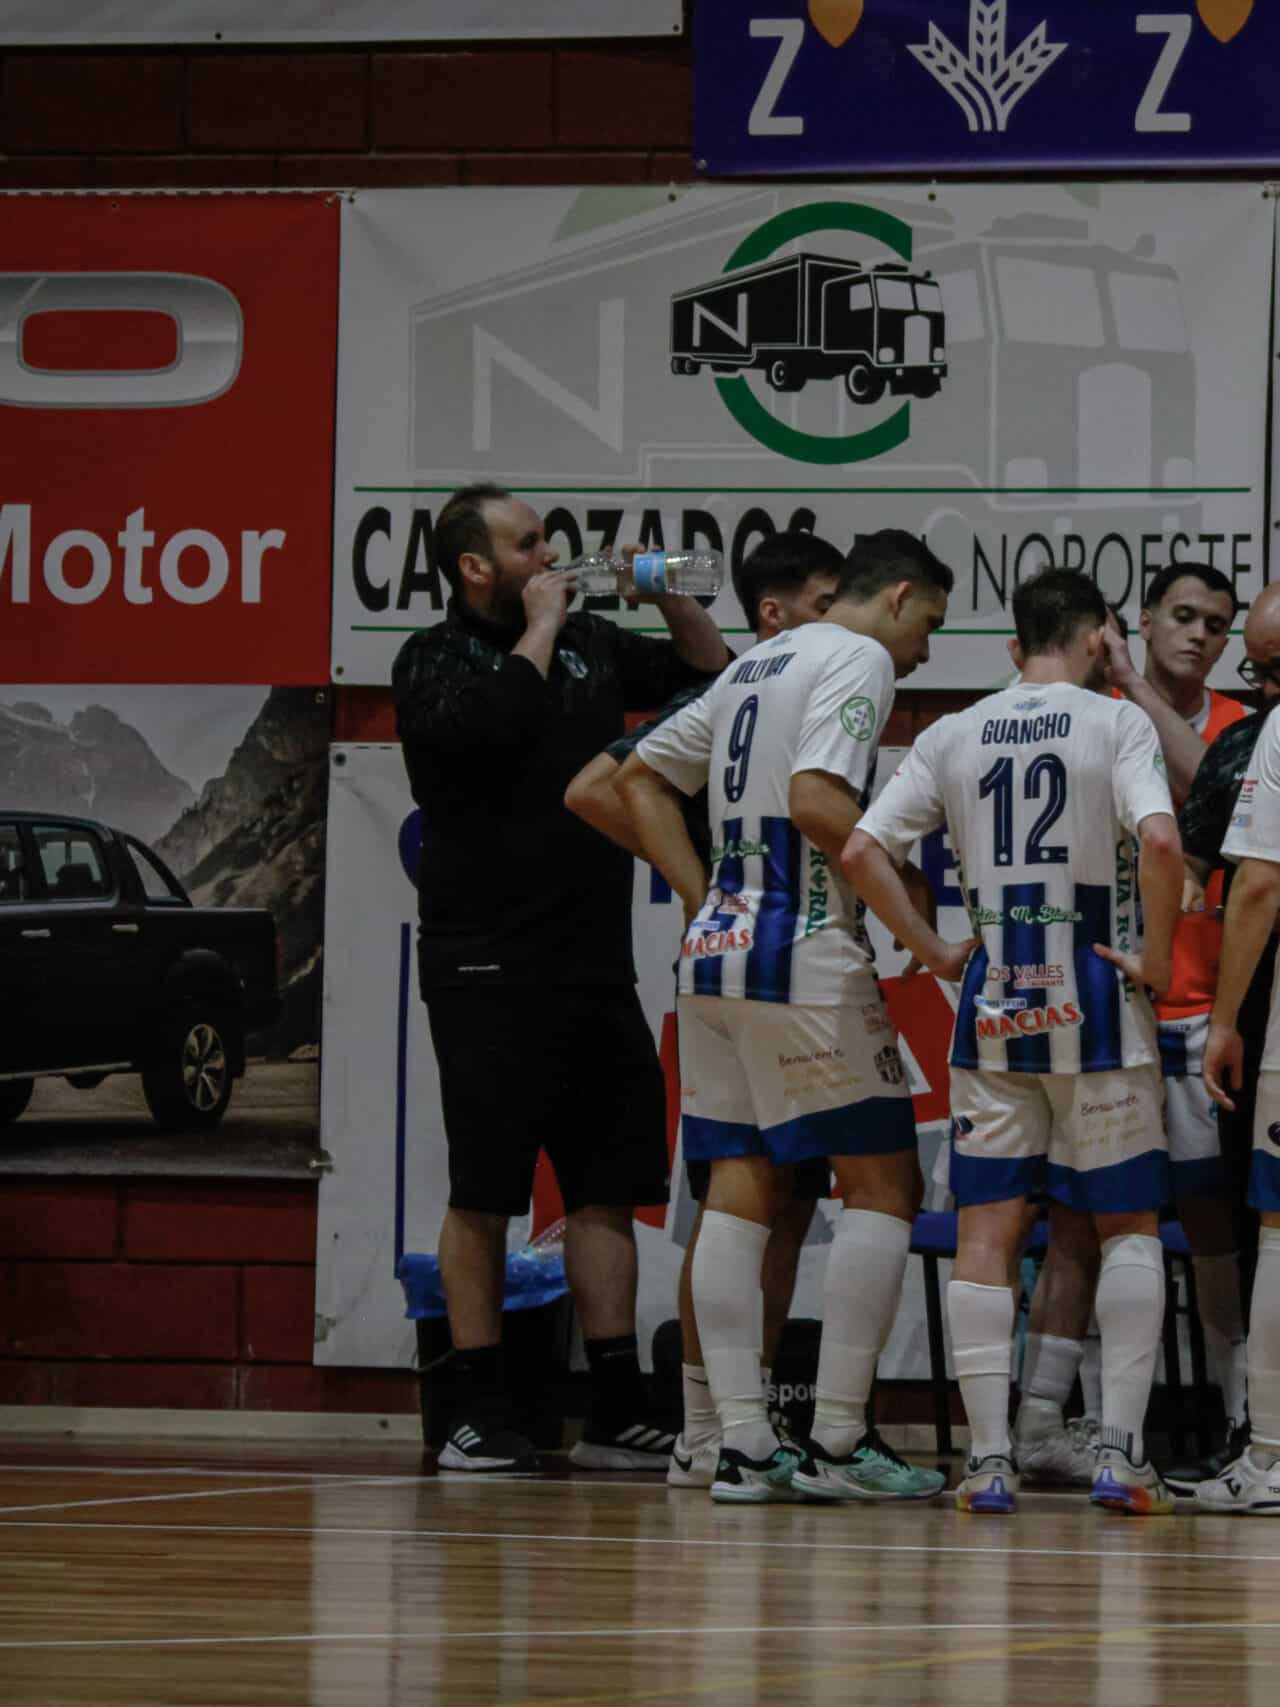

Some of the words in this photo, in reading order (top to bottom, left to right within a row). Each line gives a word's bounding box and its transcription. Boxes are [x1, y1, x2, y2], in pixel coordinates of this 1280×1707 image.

[748, 18, 805, 136] Z
[1134, 14, 1193, 132] Z
[724, 694, 758, 803] 9
[981, 712, 1072, 745] GUANCHO
[979, 752, 1069, 867] 12
[976, 1003, 1079, 1040] MACIAS
